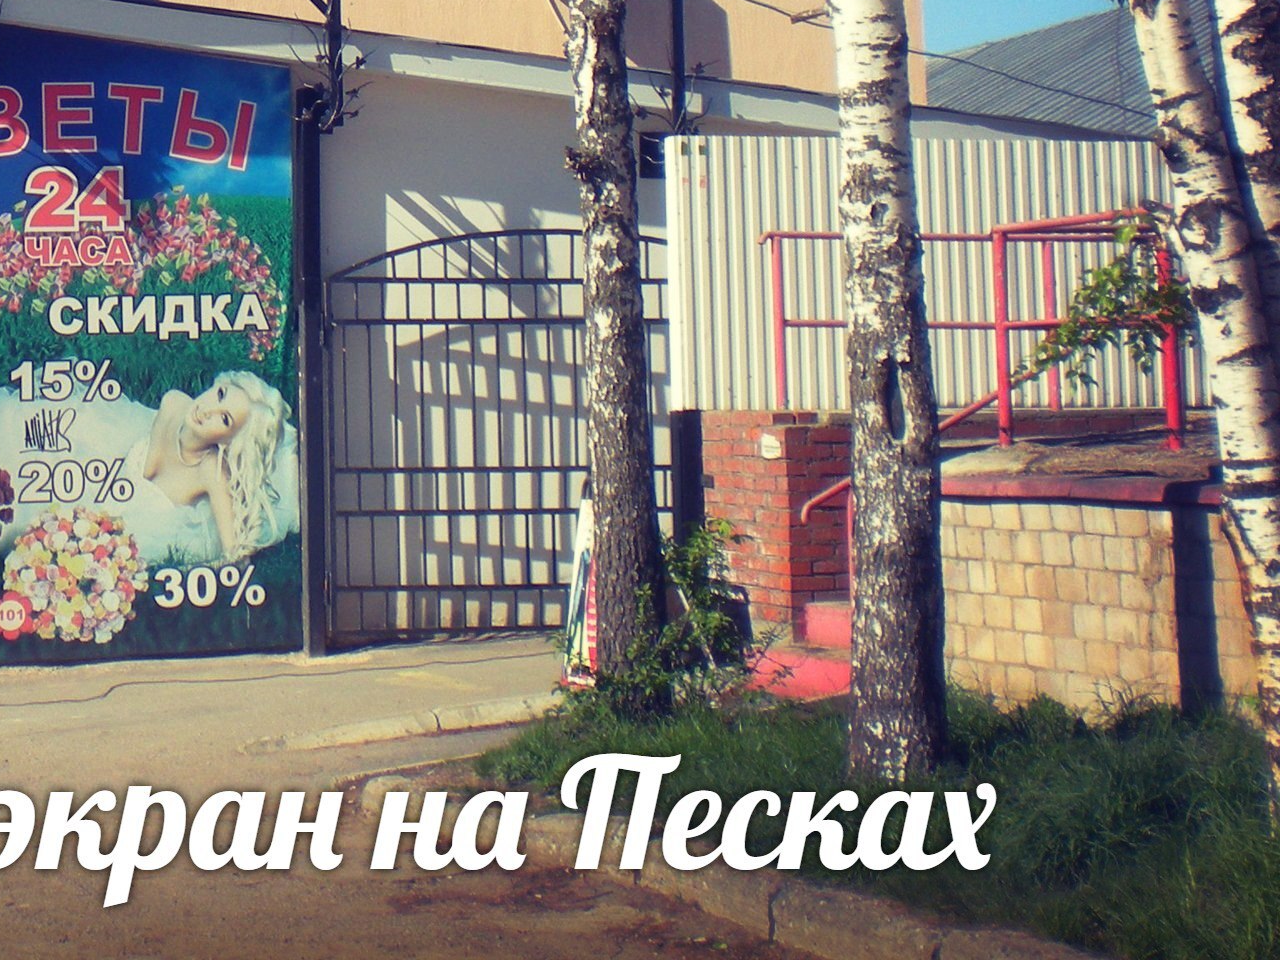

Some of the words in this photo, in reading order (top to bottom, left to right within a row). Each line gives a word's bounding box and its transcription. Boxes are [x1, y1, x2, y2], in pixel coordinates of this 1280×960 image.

[24, 165, 131, 232] 24
[24, 236, 133, 266] ЧАСА
[48, 293, 271, 340] СКИДКА
[10, 359, 122, 402] 15%
[18, 459, 134, 503] 20%
[152, 566, 267, 611] 30%
